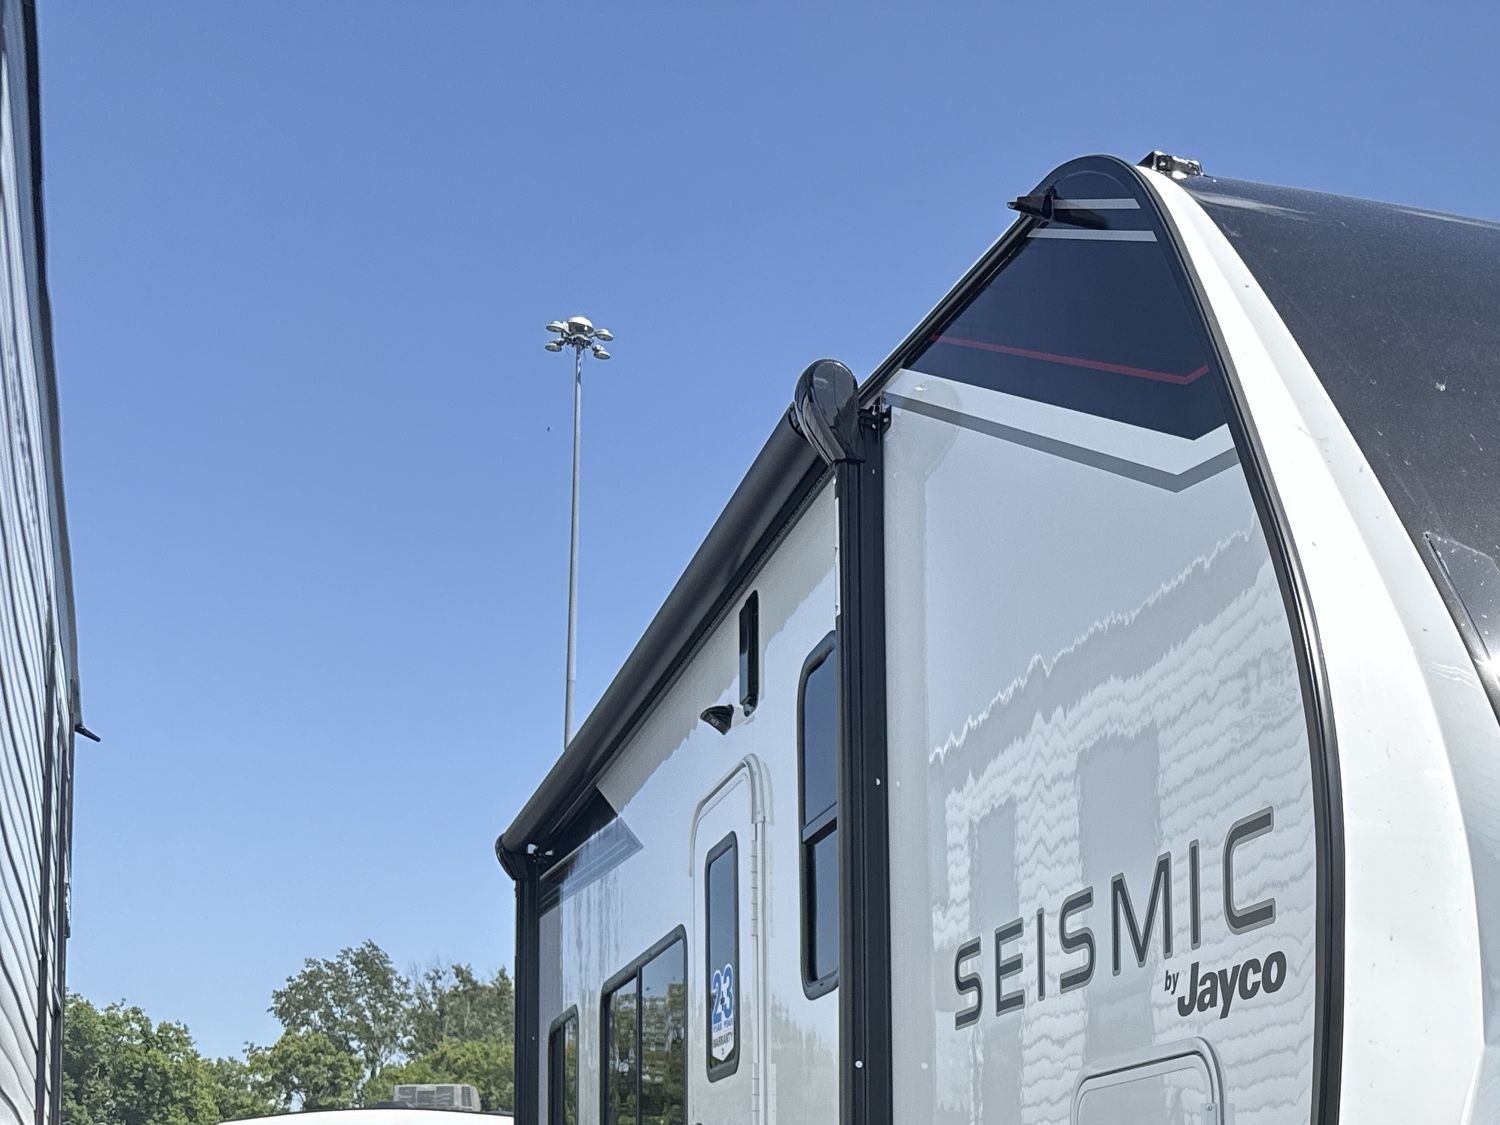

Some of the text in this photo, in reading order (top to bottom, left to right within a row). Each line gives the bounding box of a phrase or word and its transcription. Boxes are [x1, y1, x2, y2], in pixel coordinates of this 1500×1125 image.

[954, 804, 1277, 1031] SEISMIC
[1164, 950, 1287, 1020] by Jayco
